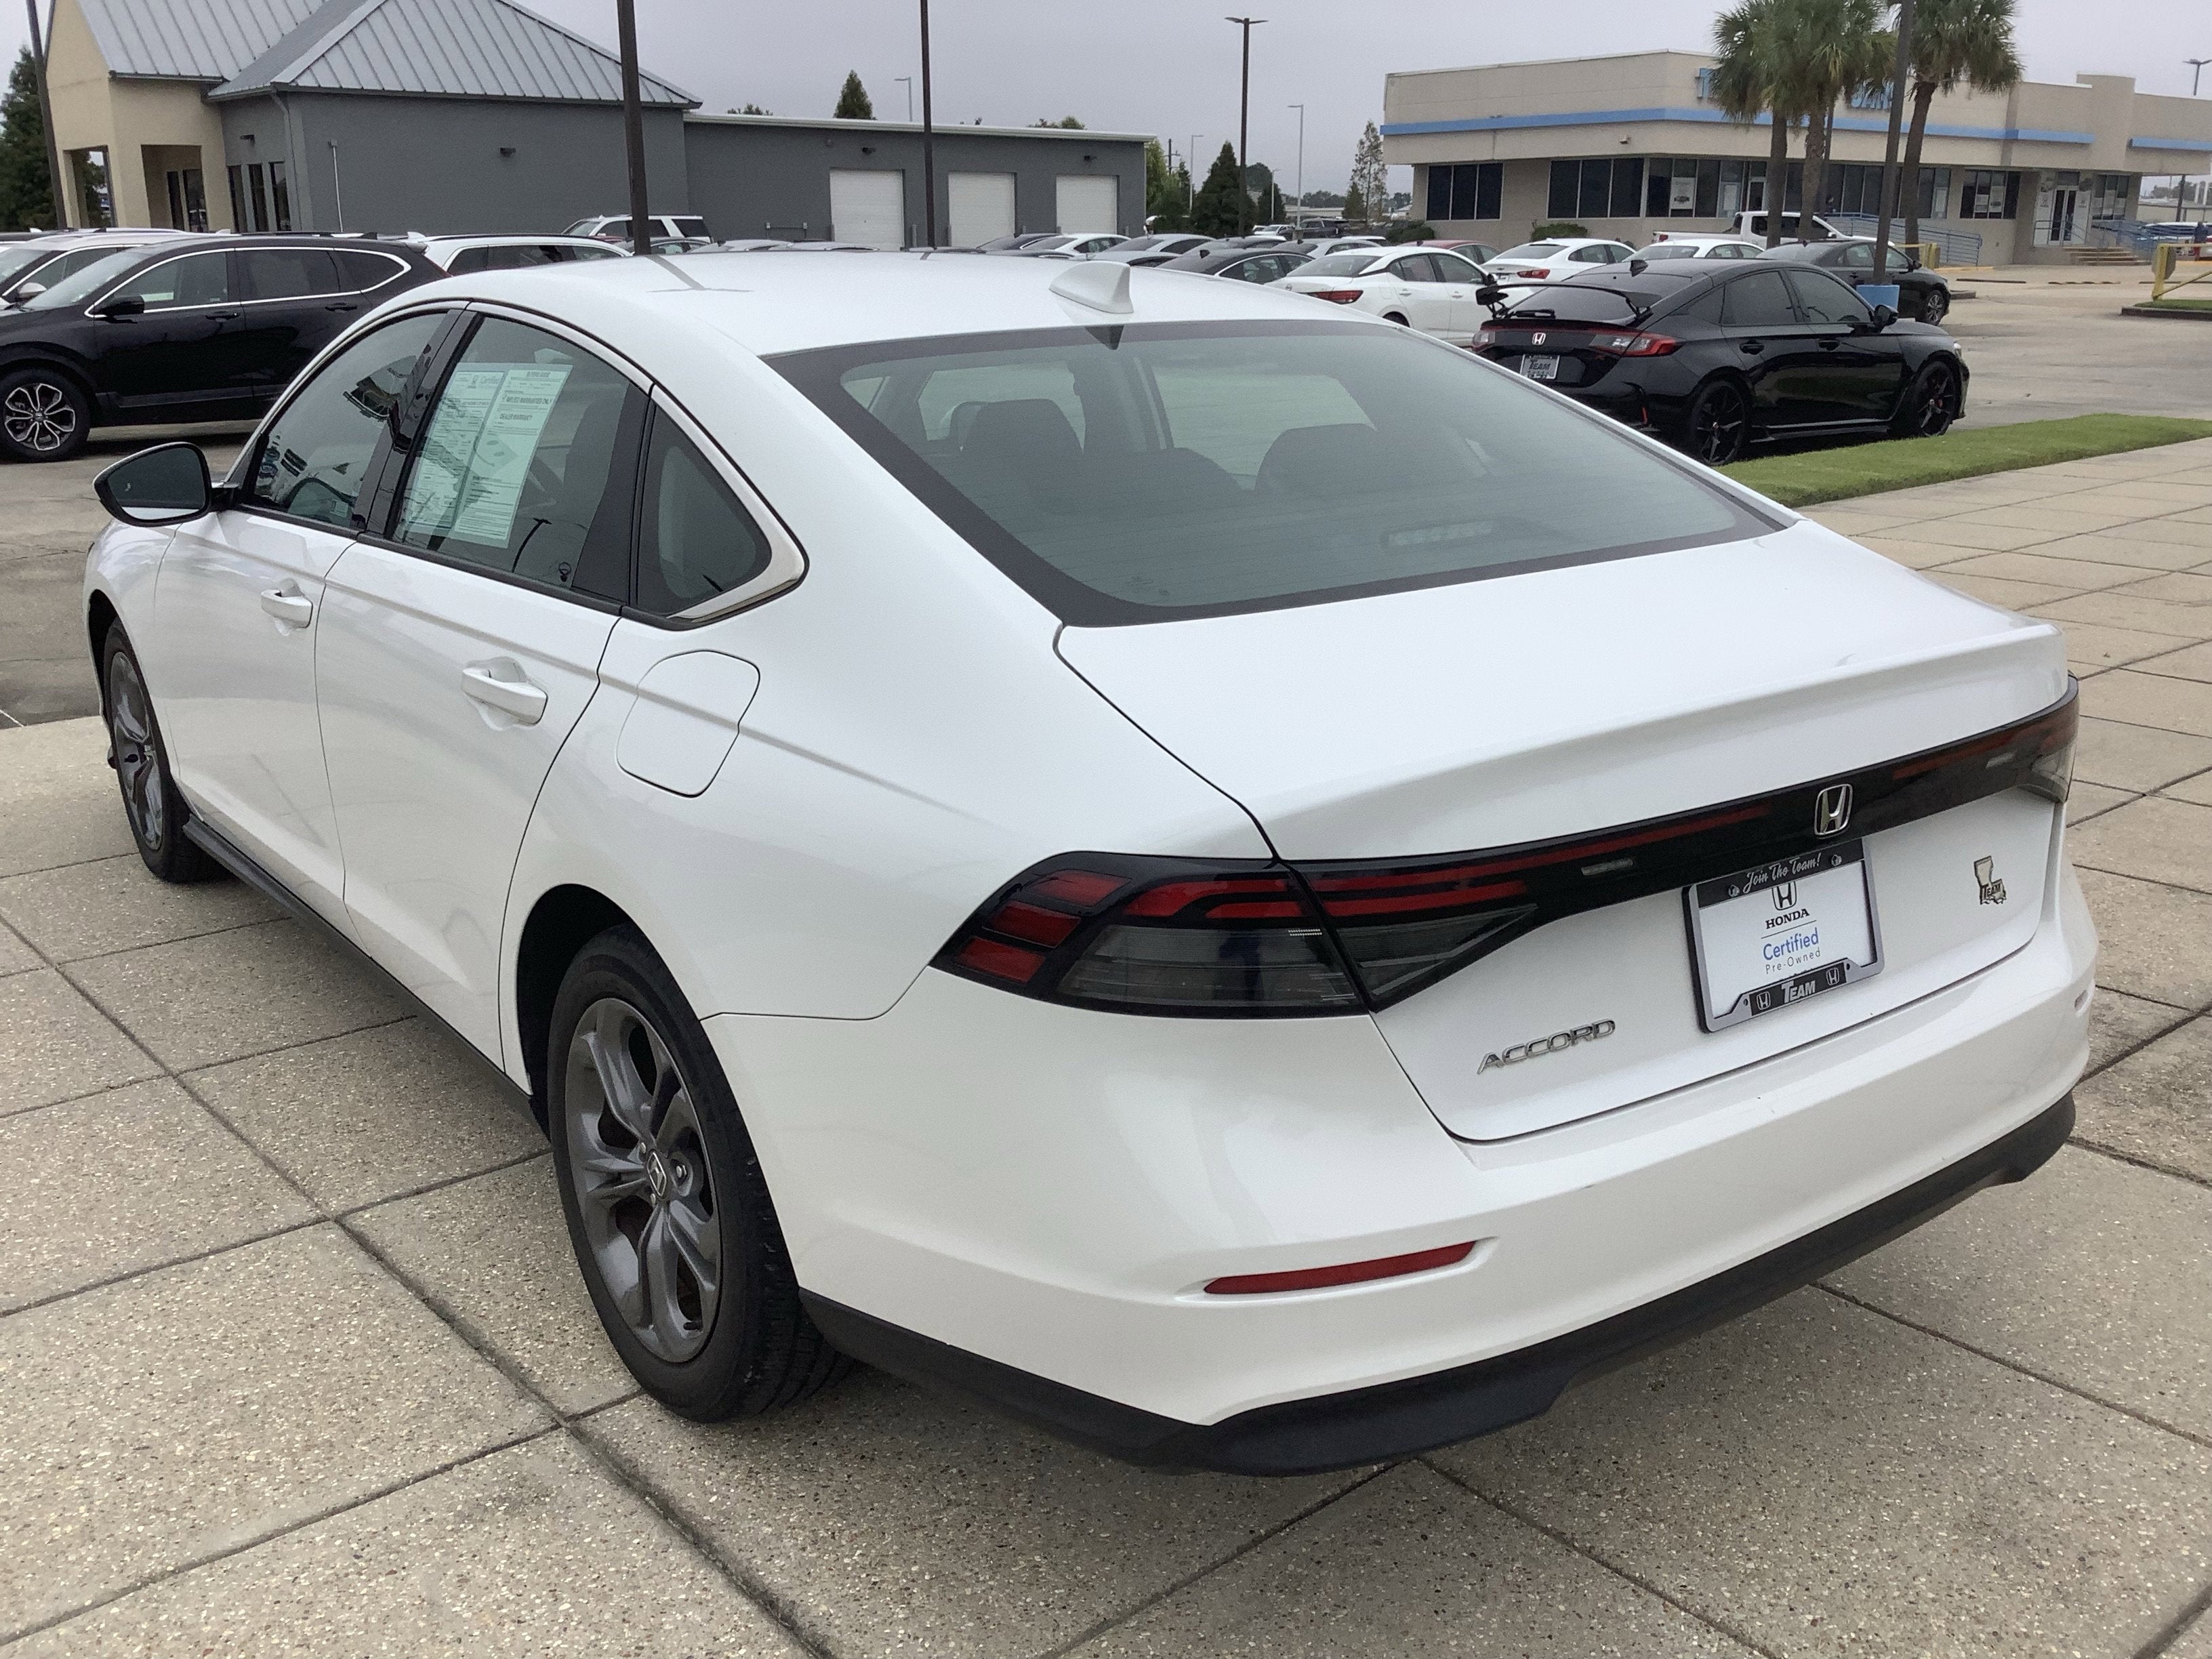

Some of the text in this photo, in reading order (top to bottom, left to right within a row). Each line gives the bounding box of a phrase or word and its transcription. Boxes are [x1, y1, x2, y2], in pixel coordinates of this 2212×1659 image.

[1529, 359, 1551, 370] TEAM
[1742, 852, 1822, 894] Join The Team!
[1981, 883, 2001, 898] TEAM
[1765, 908, 1810, 929] HONDA
[1763, 926, 1819, 960] Certified
[1765, 947, 1821, 975] Pre-Owned
[1781, 980, 1816, 1004] TEAM
[1477, 1018, 1616, 1075] ACCORD
